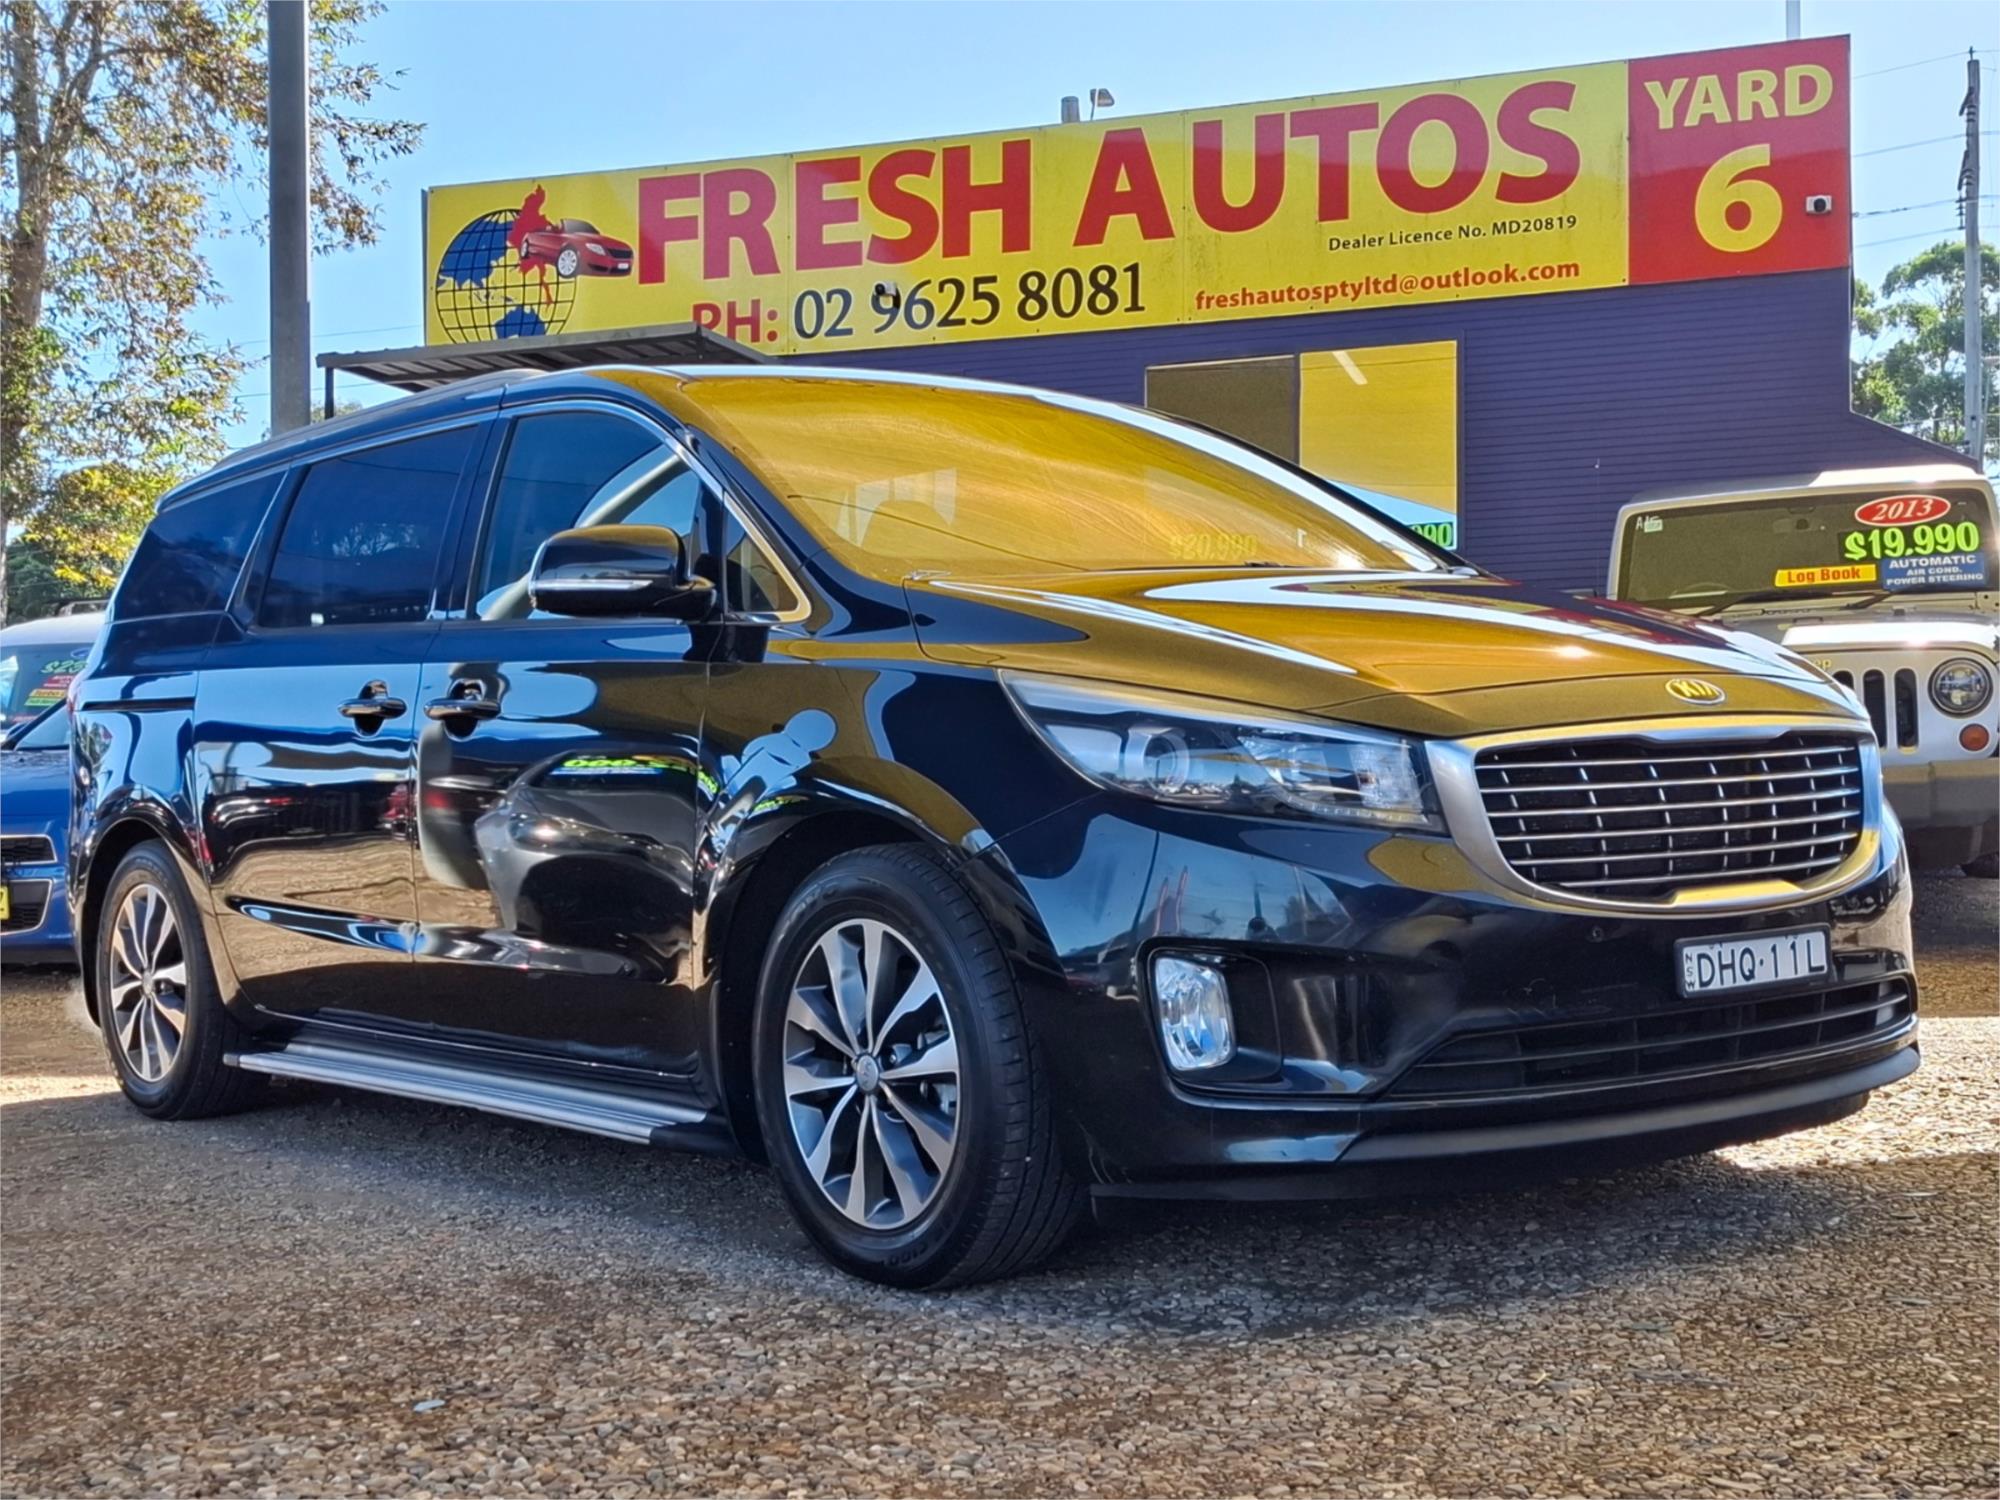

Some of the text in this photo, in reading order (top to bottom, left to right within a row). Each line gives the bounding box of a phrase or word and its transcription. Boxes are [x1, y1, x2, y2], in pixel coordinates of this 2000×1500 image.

[1643, 63, 1834, 130] YARD
[638, 80, 1582, 285] FRESH AUTOS
[1695, 143, 1783, 253] 6
[1329, 215, 1578, 251] Dealer Licence No. MD20819
[692, 262, 1146, 343] PH: 02 9625 8081
[1195, 261, 1581, 311] freshautosptyltd@outlook.com
[1871, 497, 1934, 521] 2013
[1787, 566, 1861, 584] Log Book
[1886, 572, 1984, 586] POWER STEERING
[1889, 554, 1976, 569] AUTOMATIC
[1906, 567, 1926, 577] AIR
